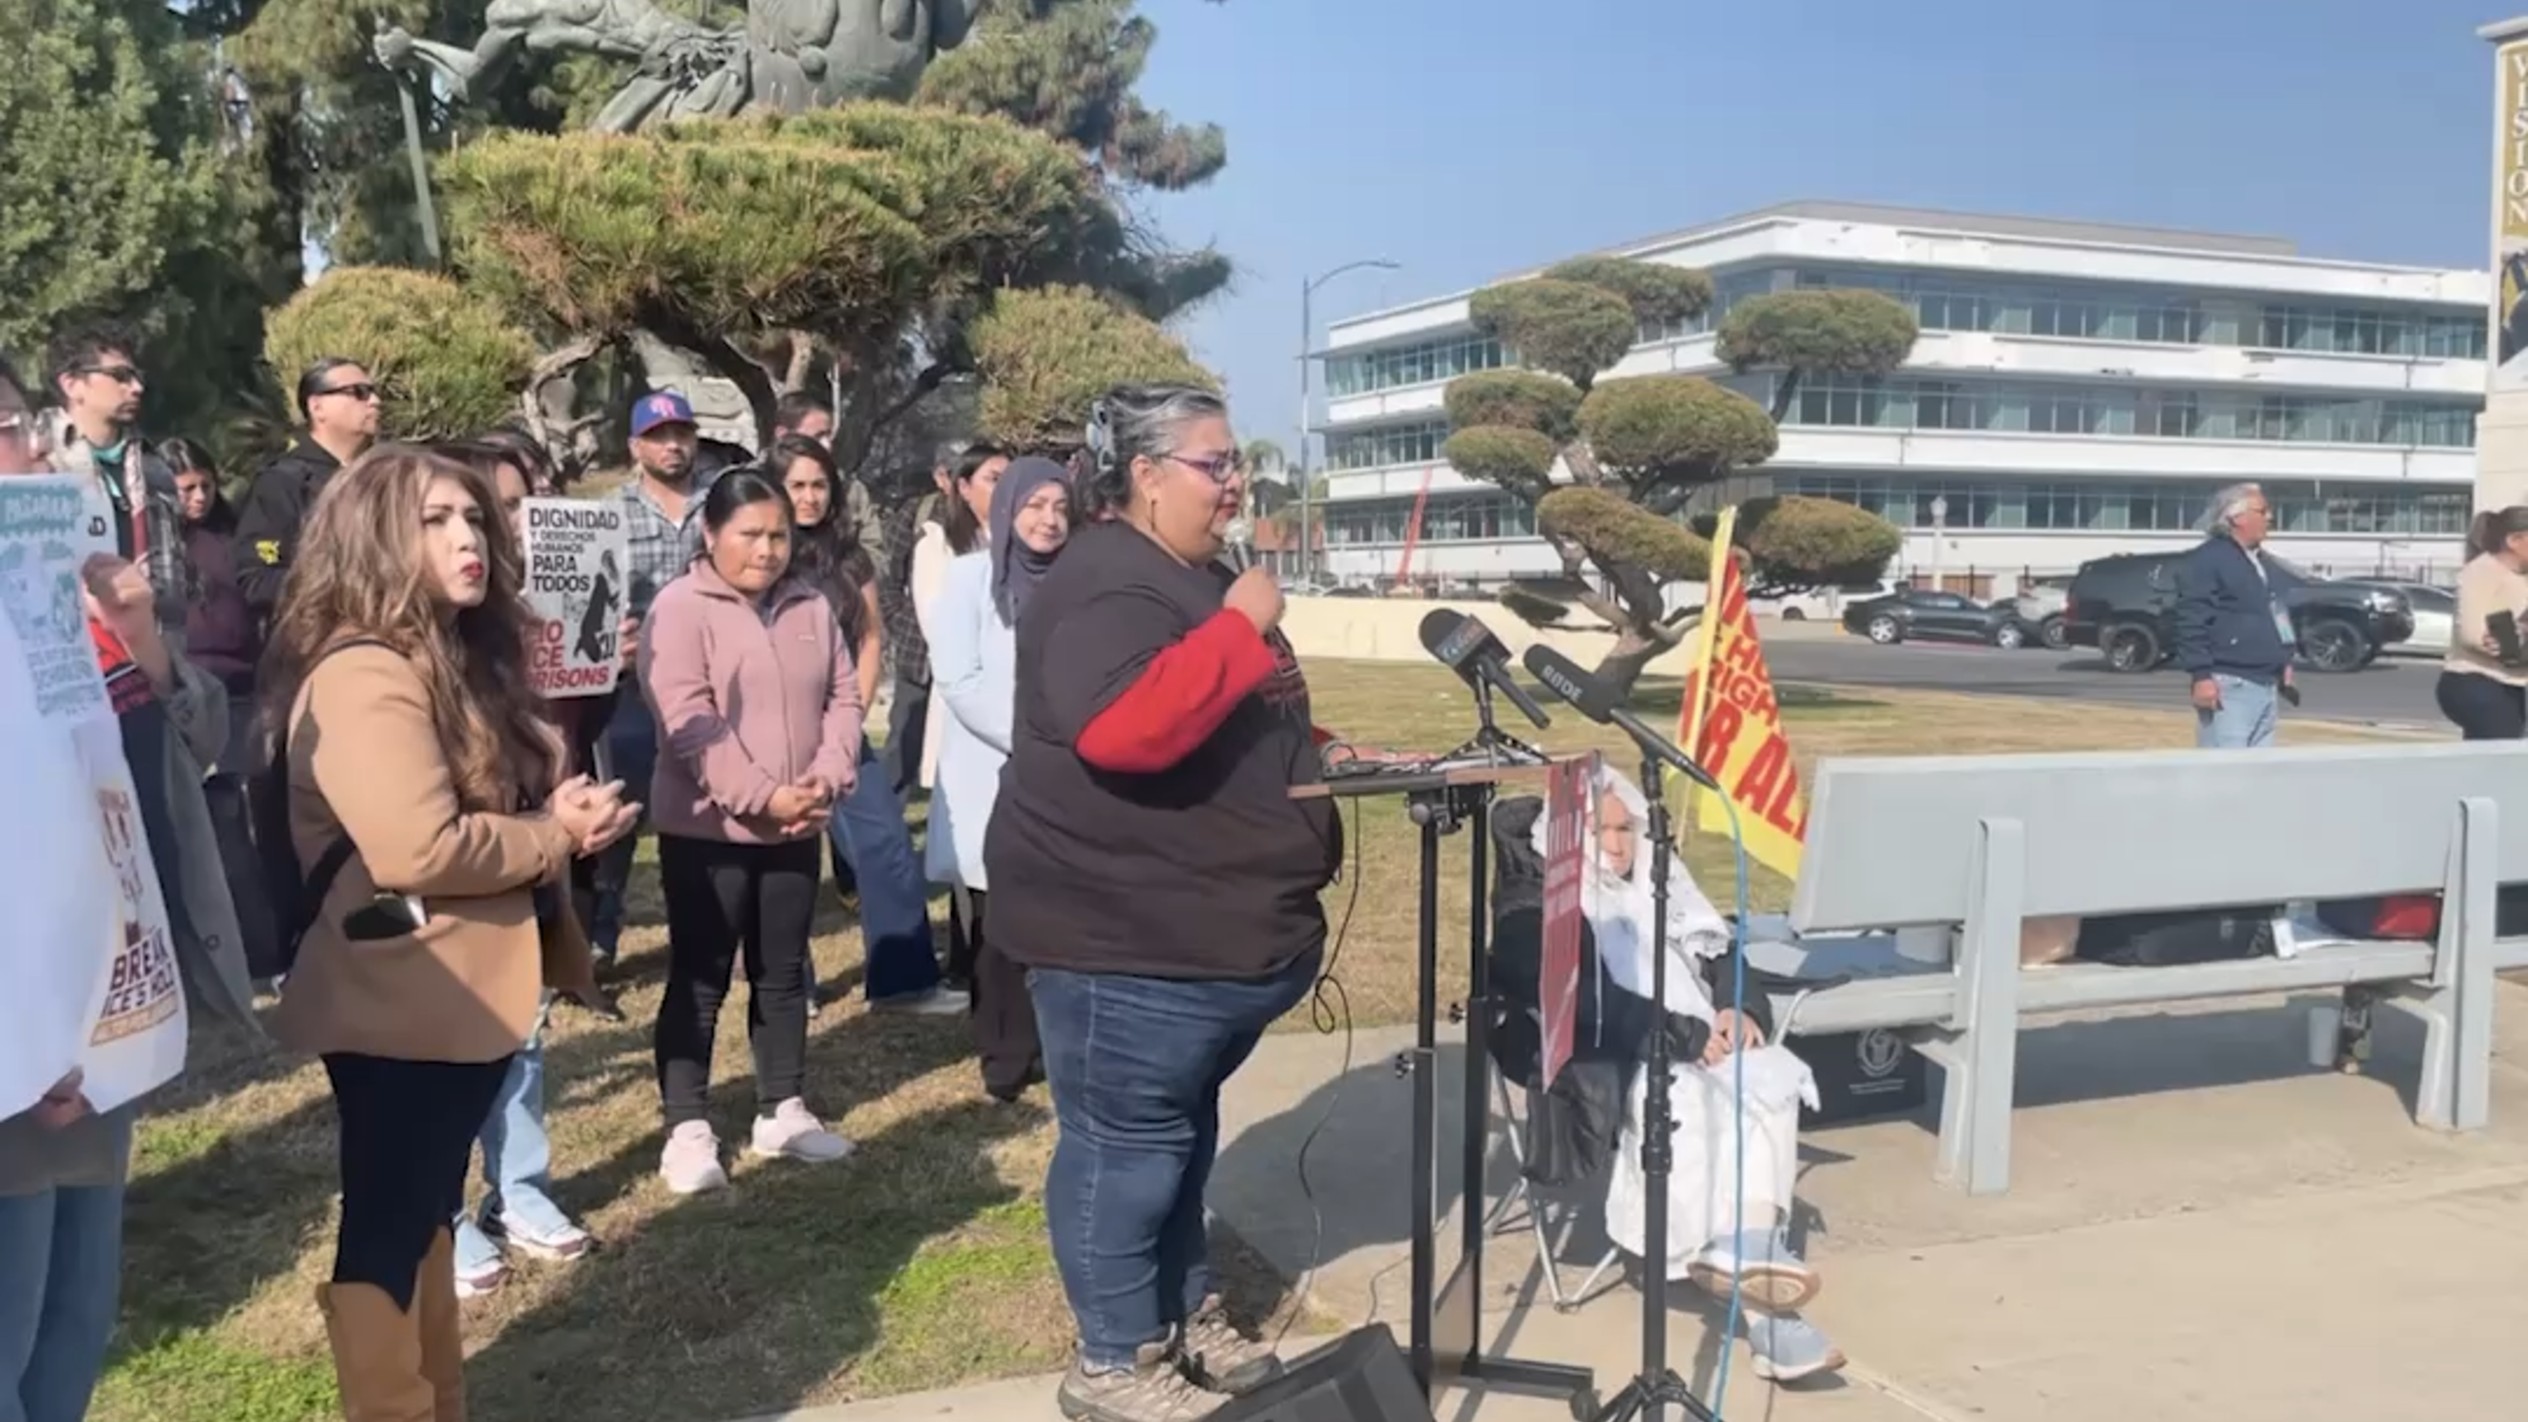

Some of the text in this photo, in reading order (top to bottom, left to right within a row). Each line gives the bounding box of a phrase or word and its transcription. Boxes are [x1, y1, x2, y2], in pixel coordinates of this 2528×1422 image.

[2508, 54, 2528, 226] VISION
[529, 507, 619, 530] DIGNIDAD
[540, 530, 596, 542] DERECHOS
[531, 542, 584, 554] HUMANOS
[533, 554, 577, 573] PARA
[532, 574, 590, 593] TODOS
[526, 666, 610, 690] RISONS
